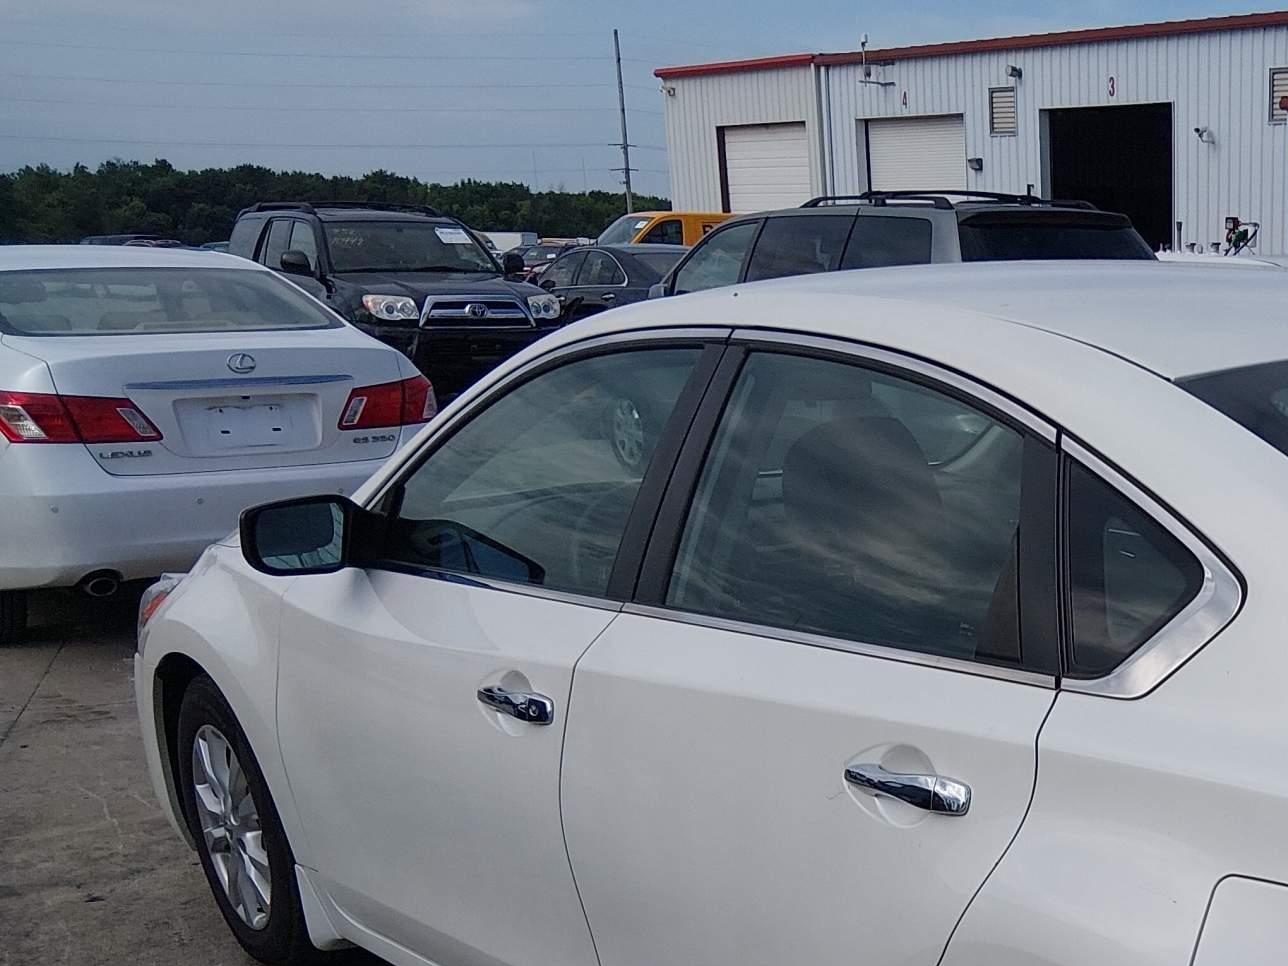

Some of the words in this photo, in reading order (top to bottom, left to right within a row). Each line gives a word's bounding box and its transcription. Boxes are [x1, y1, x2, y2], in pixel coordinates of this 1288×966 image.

[1108, 77, 1116, 97] 3
[902, 91, 908, 109] 4
[99, 449, 152, 460] LEXUS
